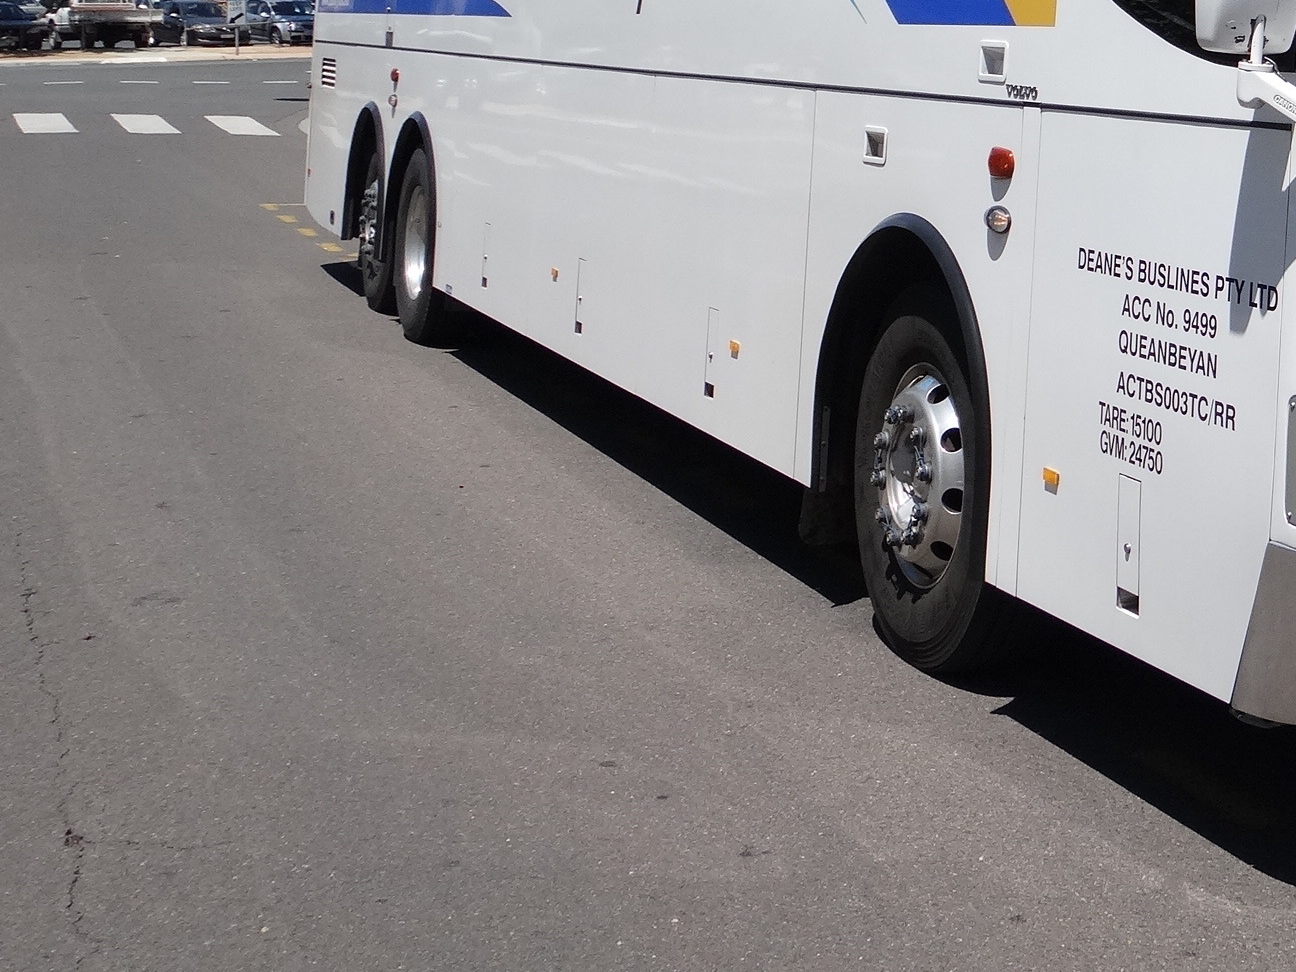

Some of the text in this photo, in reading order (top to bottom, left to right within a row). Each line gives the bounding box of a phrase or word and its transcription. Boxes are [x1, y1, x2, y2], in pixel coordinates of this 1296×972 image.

[1005, 84, 1038, 101] VOLVO
[1078, 247, 1279, 312] DEANE'S BUSLINES PTY LTD
[1122, 293, 1218, 339] ACC No. 9499
[1118, 329, 1218, 379] QUEANBEYAN
[1116, 371, 1236, 431] ACTBS003TC/RR
